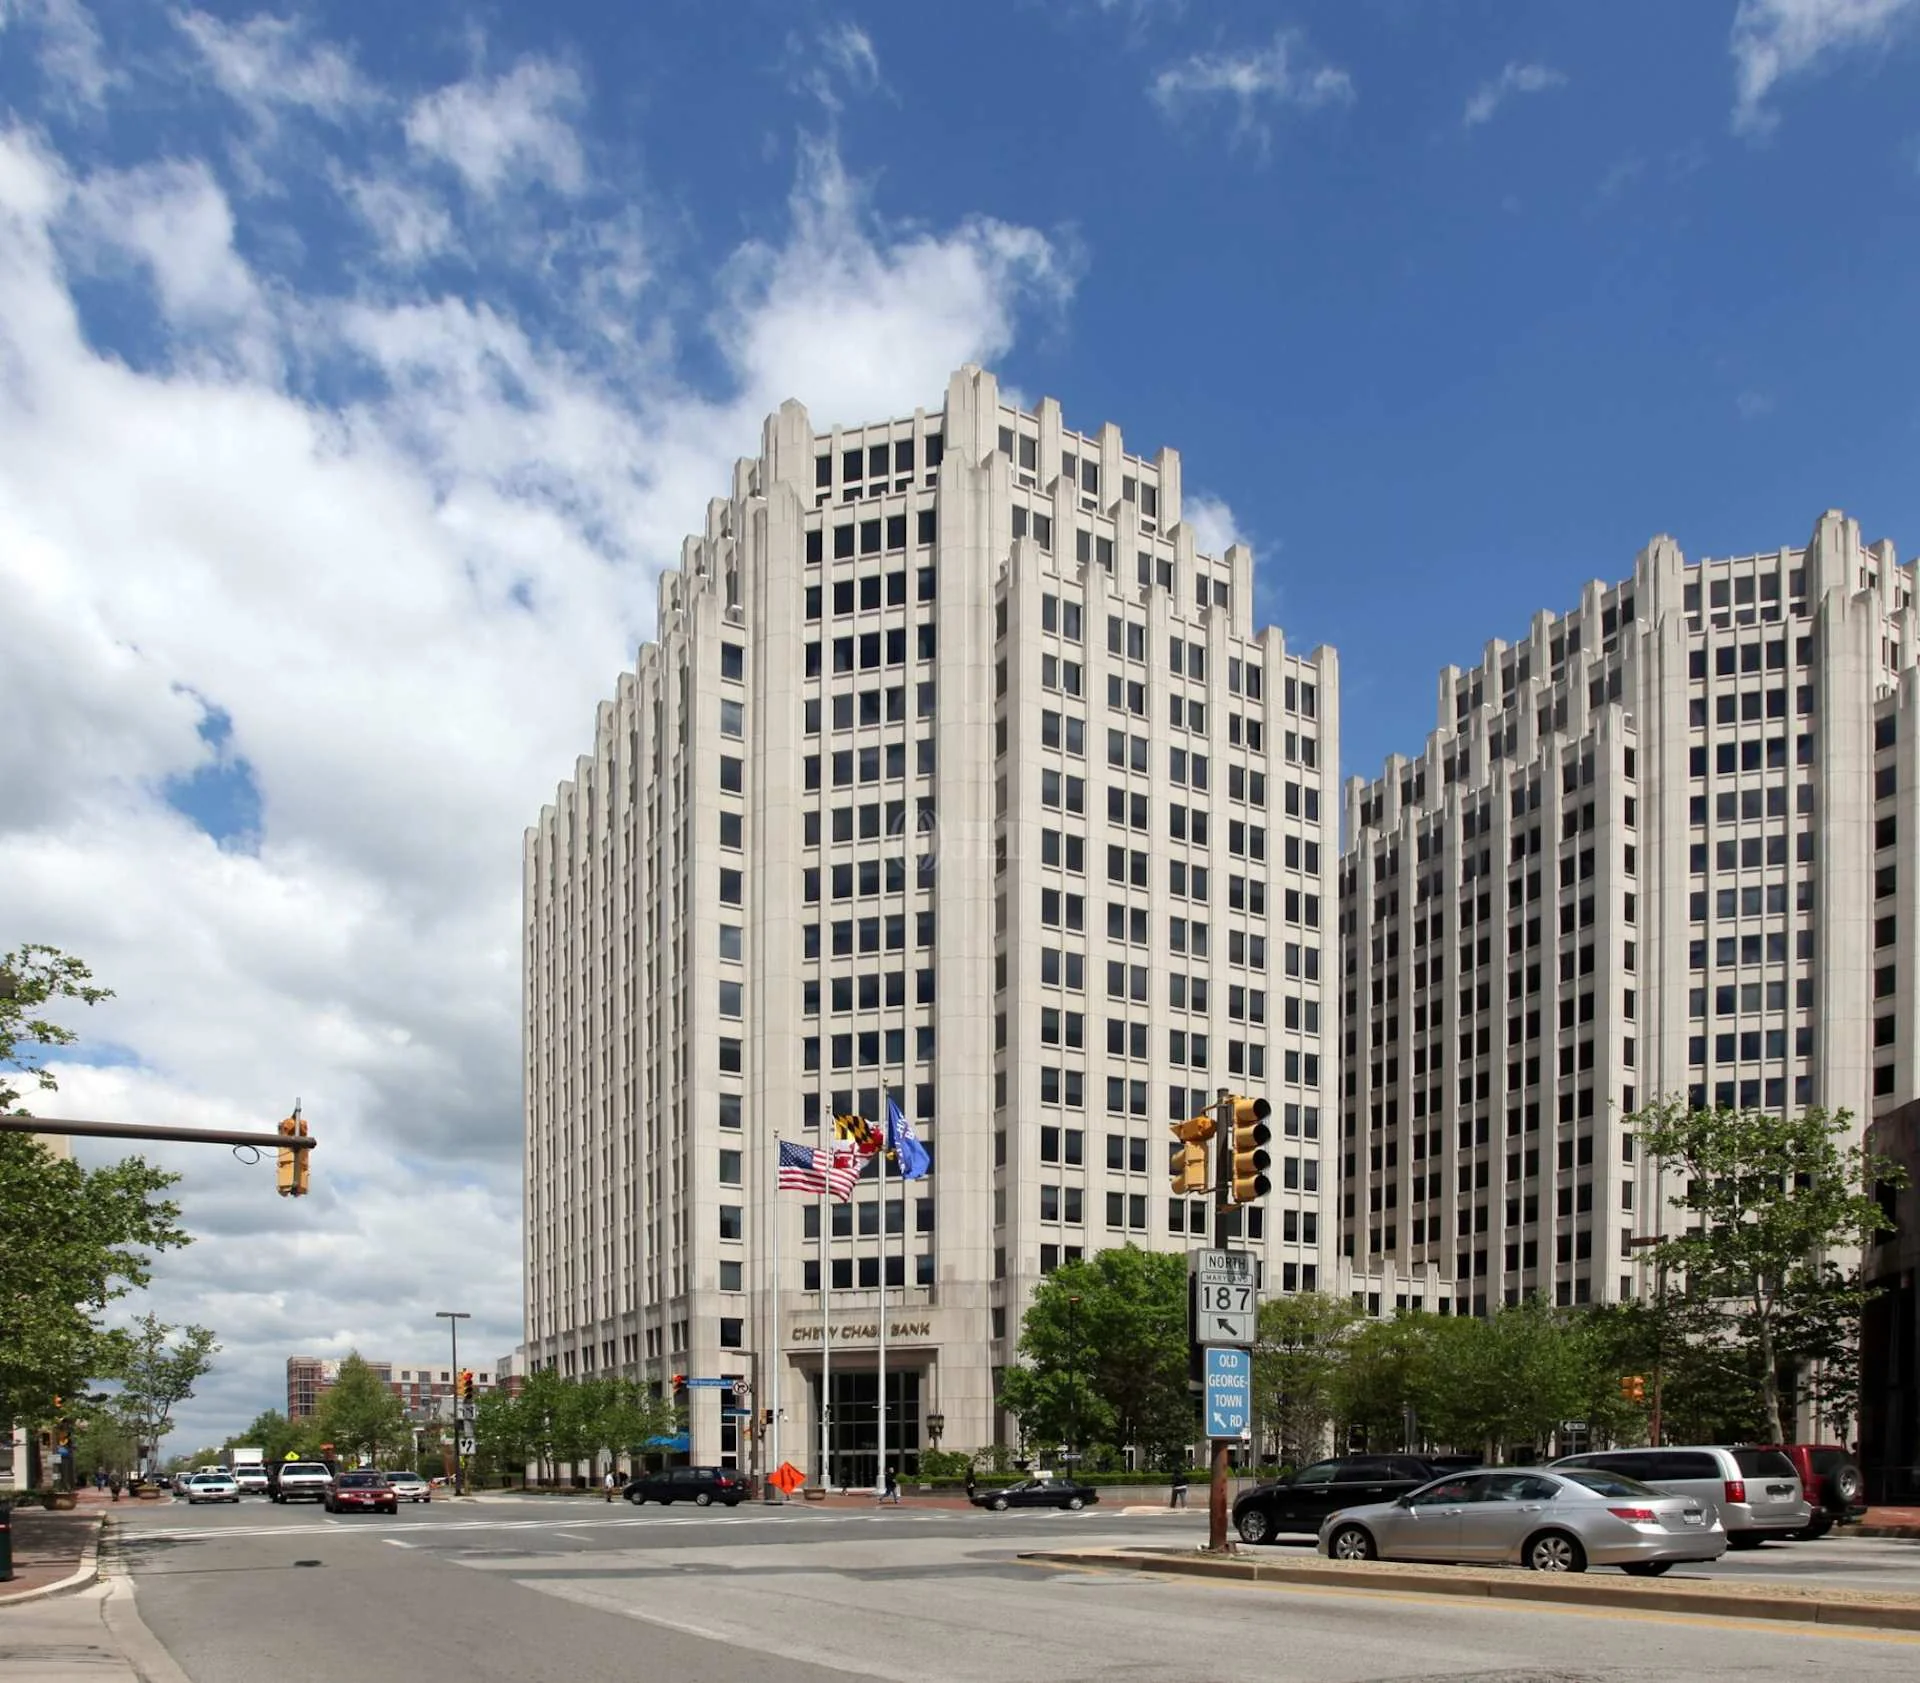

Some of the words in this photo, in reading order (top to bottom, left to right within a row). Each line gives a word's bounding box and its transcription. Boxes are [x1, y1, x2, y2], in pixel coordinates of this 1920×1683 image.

[1209, 1255, 1246, 1269] NORTH
[1204, 1286, 1250, 1311] 187
[841, 1323, 881, 1340] CHAS
[890, 1322, 930, 1337] BANK
[1219, 1354, 1238, 1369] OLD
[1208, 1374, 1248, 1388] GEORGE-
[1215, 1394, 1243, 1408] TOWN
[1230, 1414, 1242, 1427] RD
